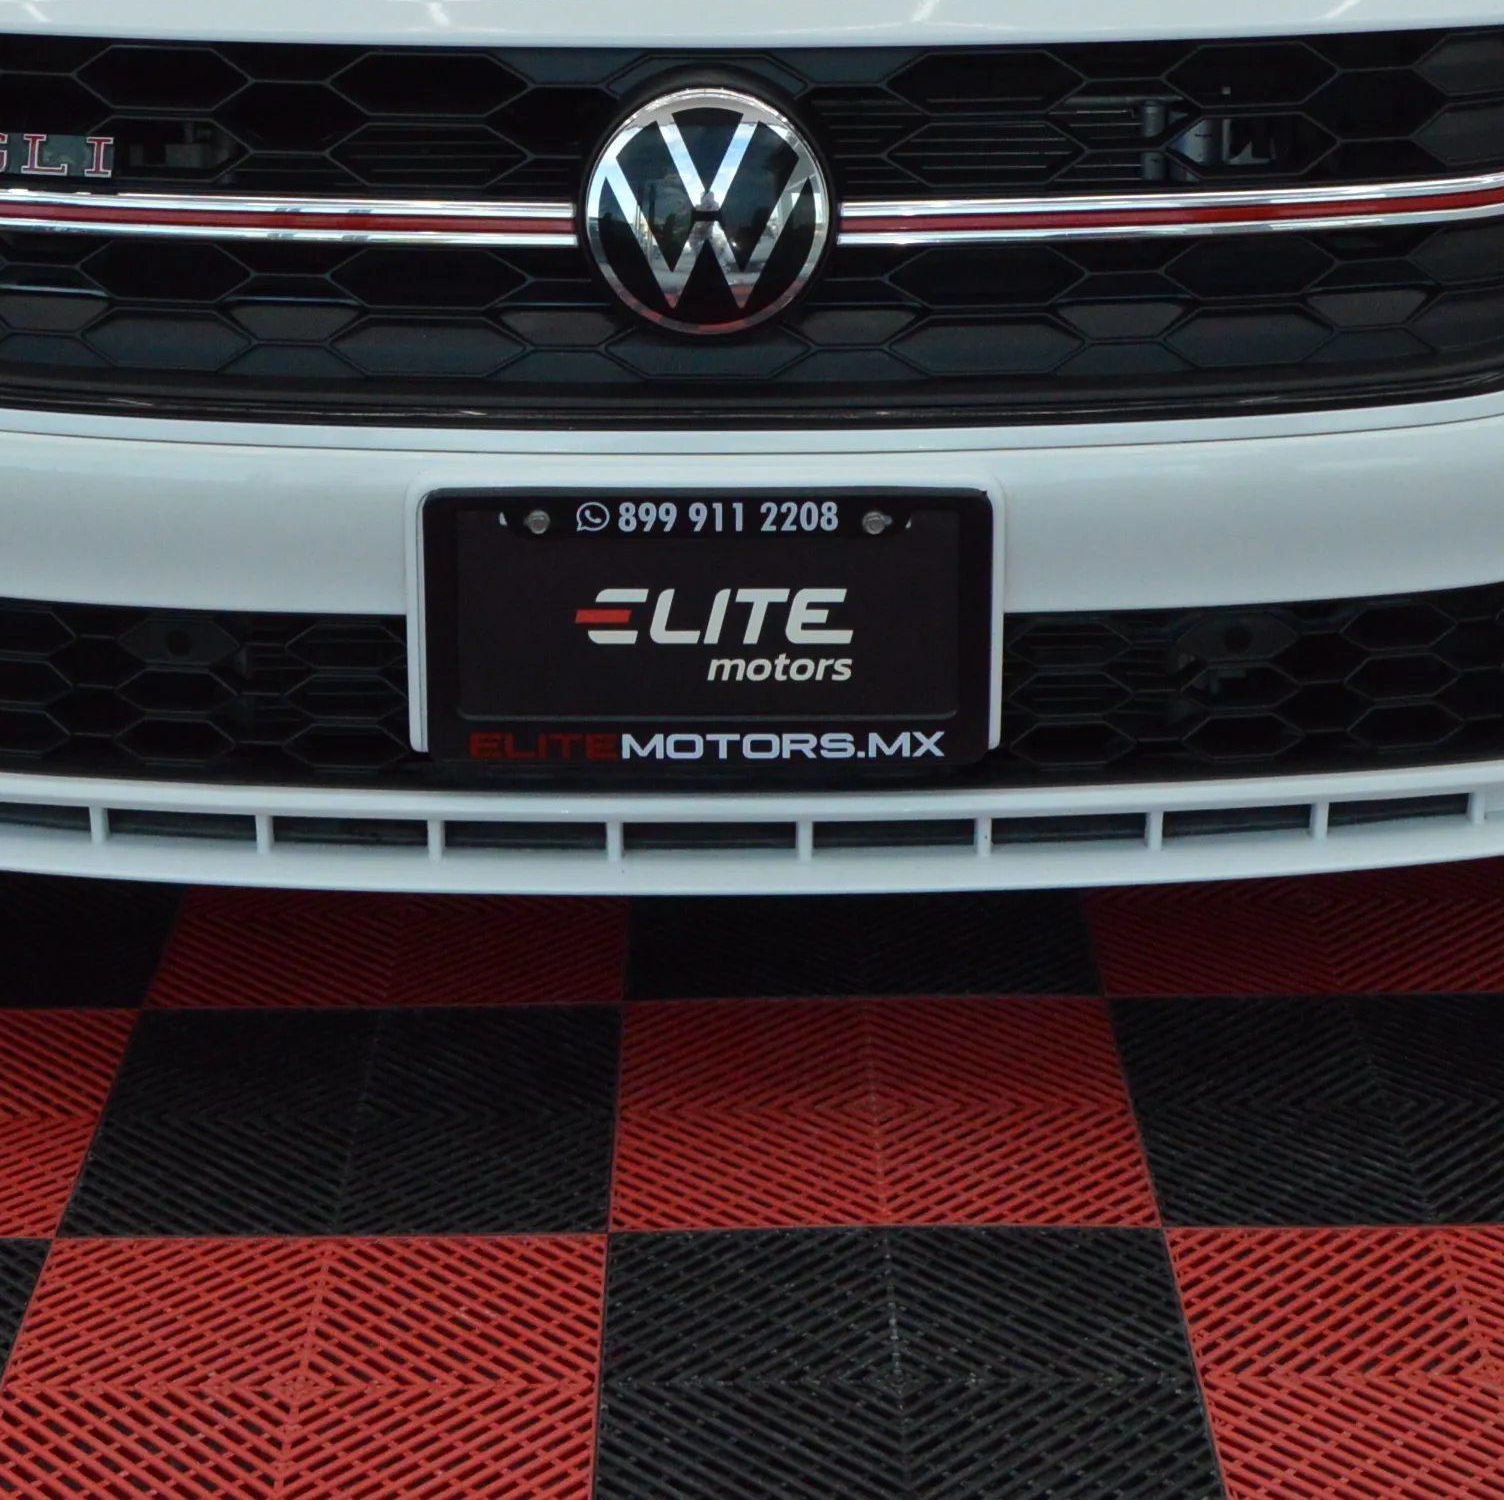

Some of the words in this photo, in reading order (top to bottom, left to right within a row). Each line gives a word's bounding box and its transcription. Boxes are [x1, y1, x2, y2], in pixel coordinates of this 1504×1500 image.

[617, 502, 676, 532] 899
[688, 502, 746, 532] 911
[759, 502, 839, 532] 2208
[575, 588, 855, 644] ELITE
[707, 653, 853, 681] motors
[470, 731, 946, 760] ELITEMOTORS.MX
